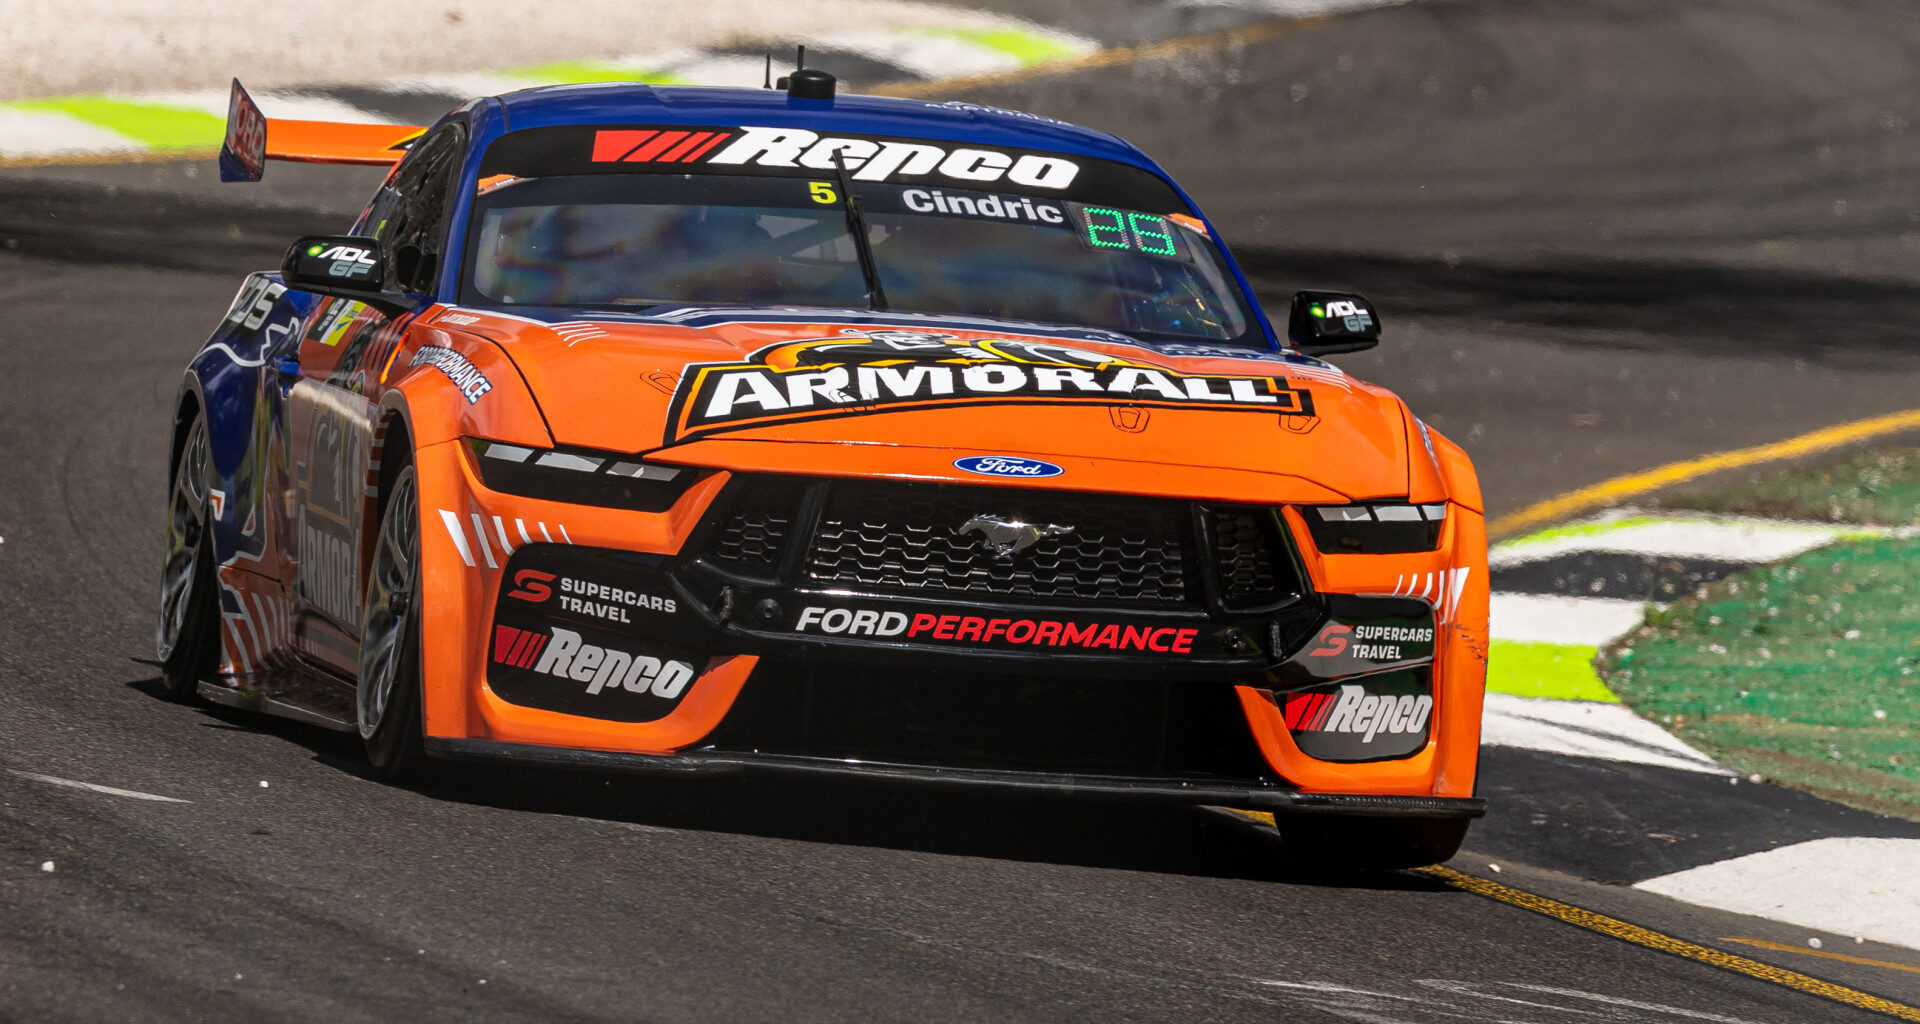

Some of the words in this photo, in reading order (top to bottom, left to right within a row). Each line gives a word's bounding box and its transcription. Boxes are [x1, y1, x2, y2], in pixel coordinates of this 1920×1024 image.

[707, 126, 1079, 191] Repco
[809, 182, 838, 205] 5
[904, 189, 1065, 225] Cindric
[318, 246, 377, 265] ADL
[329, 260, 373, 278] GF
[1326, 300, 1368, 318] ADL
[1344, 314, 1373, 332] GF
[975, 457, 1046, 477] Ford
[560, 577, 677, 613] SUPERCARS
[560, 595, 631, 624] TRAVEL
[1355, 625, 1433, 642] SUPERCARS
[535, 626, 695, 699] Repco
[1352, 644, 1402, 660] TRAVEL
[1325, 684, 1433, 743] Repco
